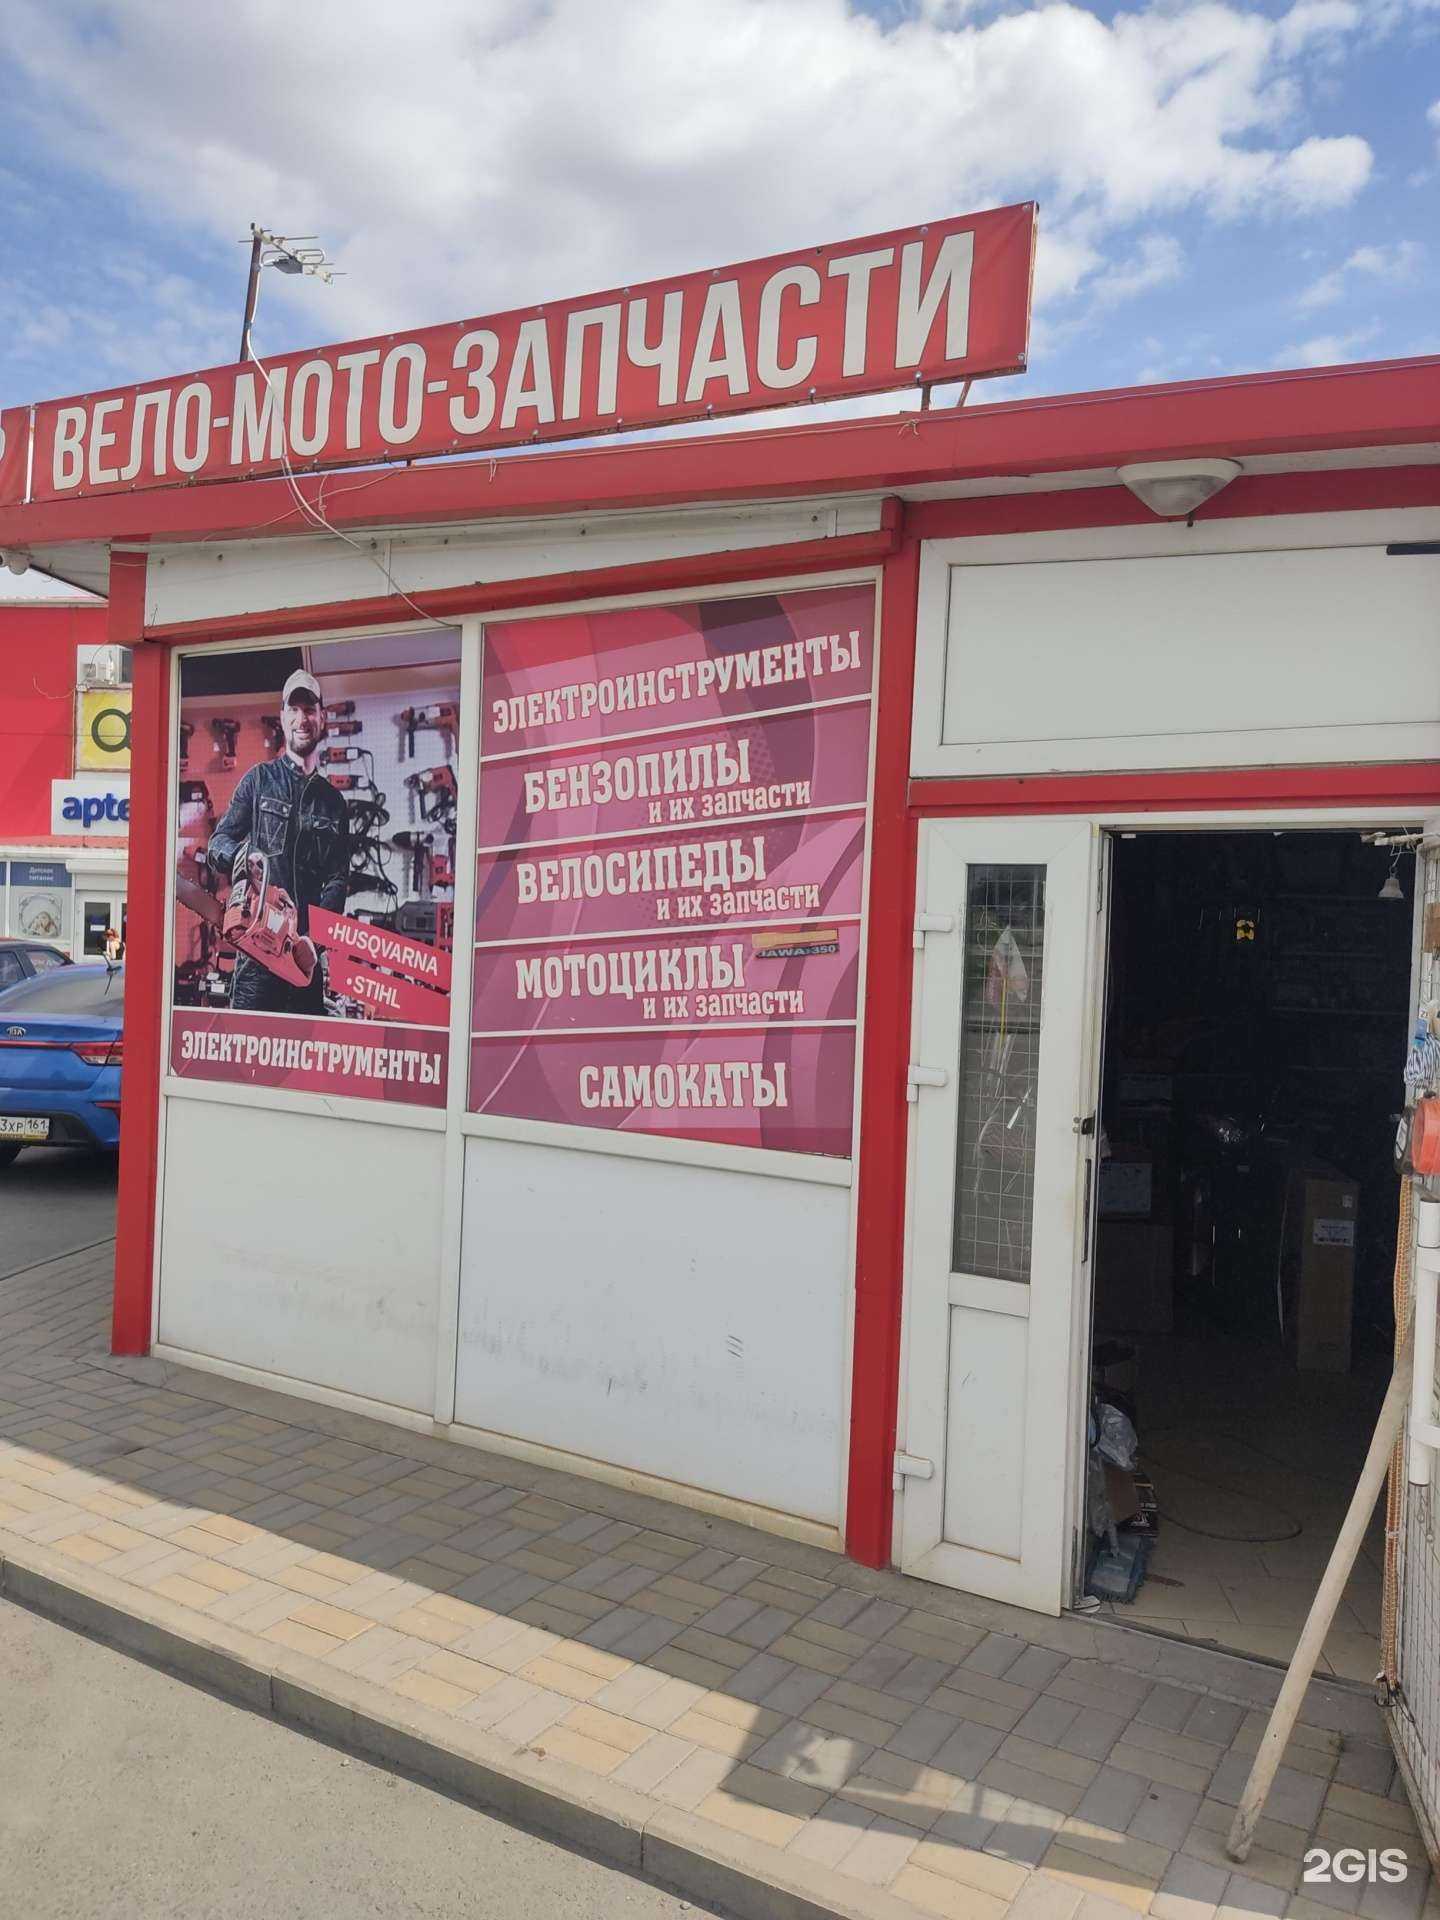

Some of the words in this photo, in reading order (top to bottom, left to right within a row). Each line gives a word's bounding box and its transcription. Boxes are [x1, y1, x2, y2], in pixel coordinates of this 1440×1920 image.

[52, 230, 975, 491] ВЕЛО-МОТО-ЗАПЧАСТИ
[492, 630, 862, 733] ЭЛЕКТРОИНСТРУМЕНТЫ
[523, 738, 751, 814] БЕНЗОПИЛЫ
[648, 801, 663, 823] и
[668, 796, 695, 821] их
[701, 780, 811, 816] запчасти
[515, 836, 767, 904] ВЕЛОСИПЕДЫ
[656, 898, 671, 920] и
[677, 895, 704, 918] их
[709, 883, 821, 915] запчасти
[515, 943, 745, 1000] МОТОЦИКЛЫ
[642, 997, 657, 1019] и
[663, 996, 689, 1018] их
[695, 989, 804, 1018] запчасти
[181, 1030, 441, 1084] ЭЛЕКТРОИНСТРУМЕНТЫ
[579, 1062, 788, 1108] САМОКАТЫ
